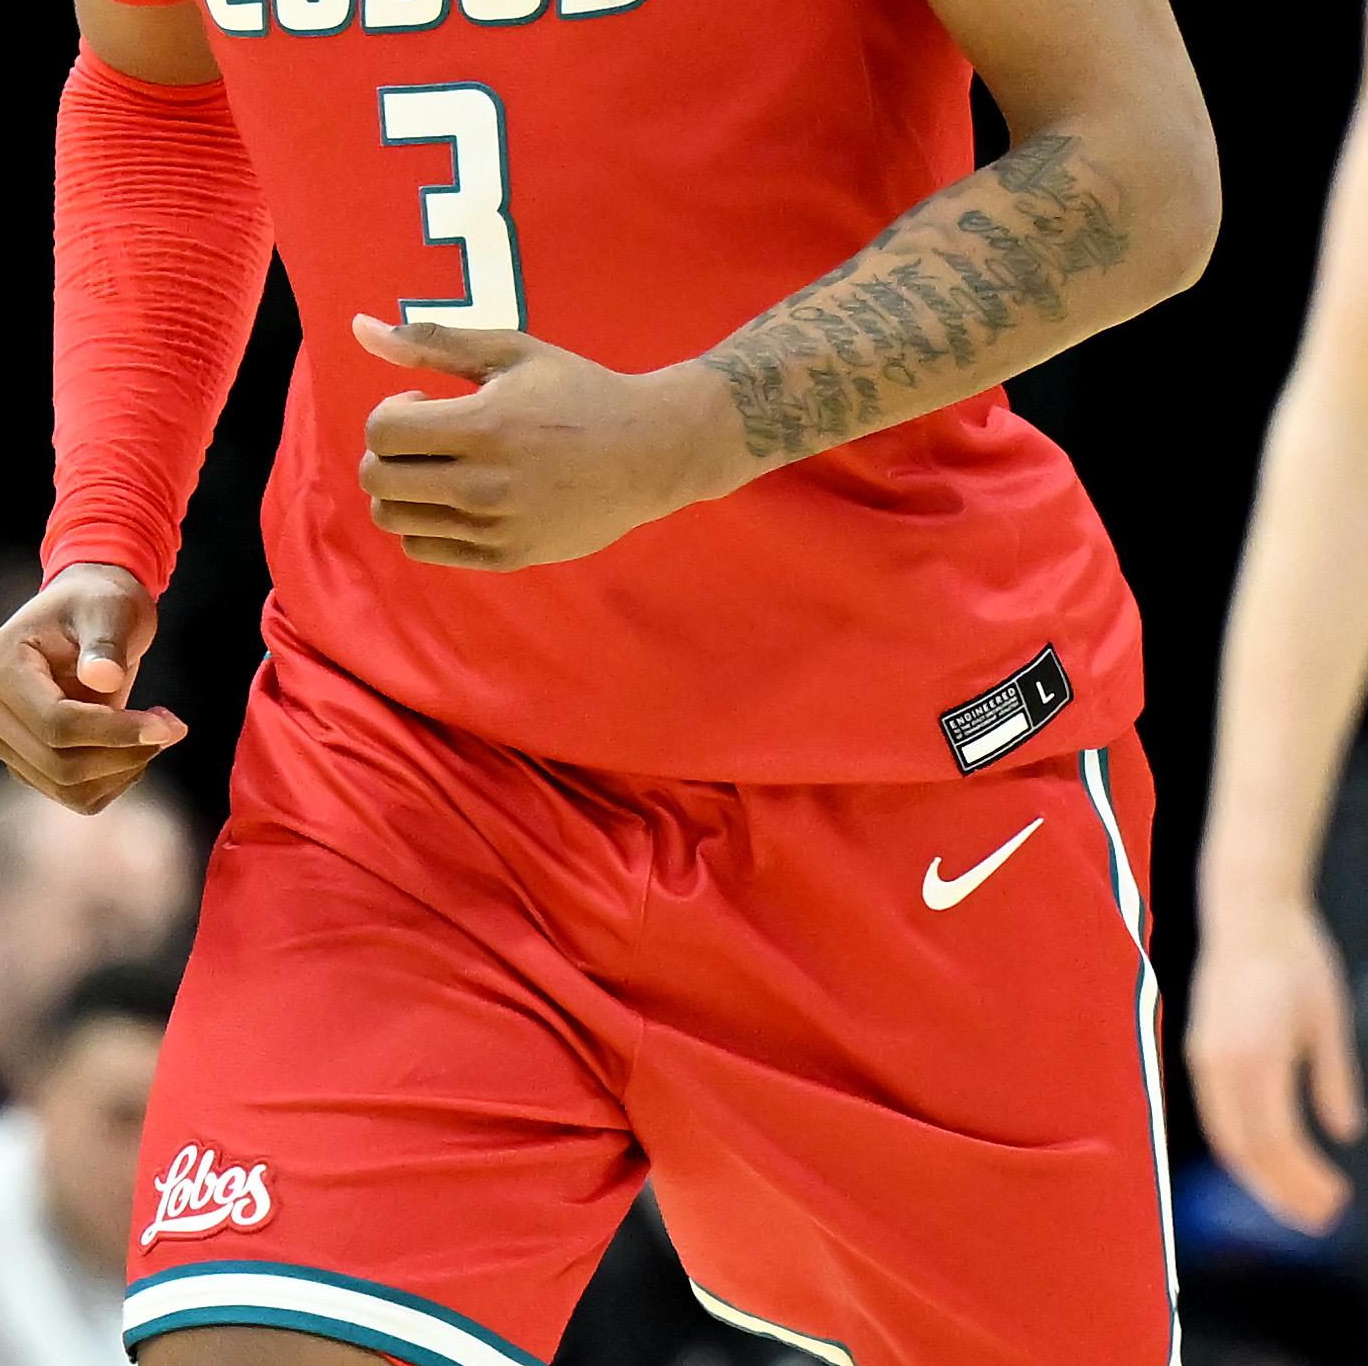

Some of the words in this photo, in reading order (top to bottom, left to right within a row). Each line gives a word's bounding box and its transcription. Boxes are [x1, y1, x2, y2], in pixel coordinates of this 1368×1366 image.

[377, 81, 528, 333] 3
[1035, 680, 1055, 705] L
[140, 1145, 271, 1246] Lobos
